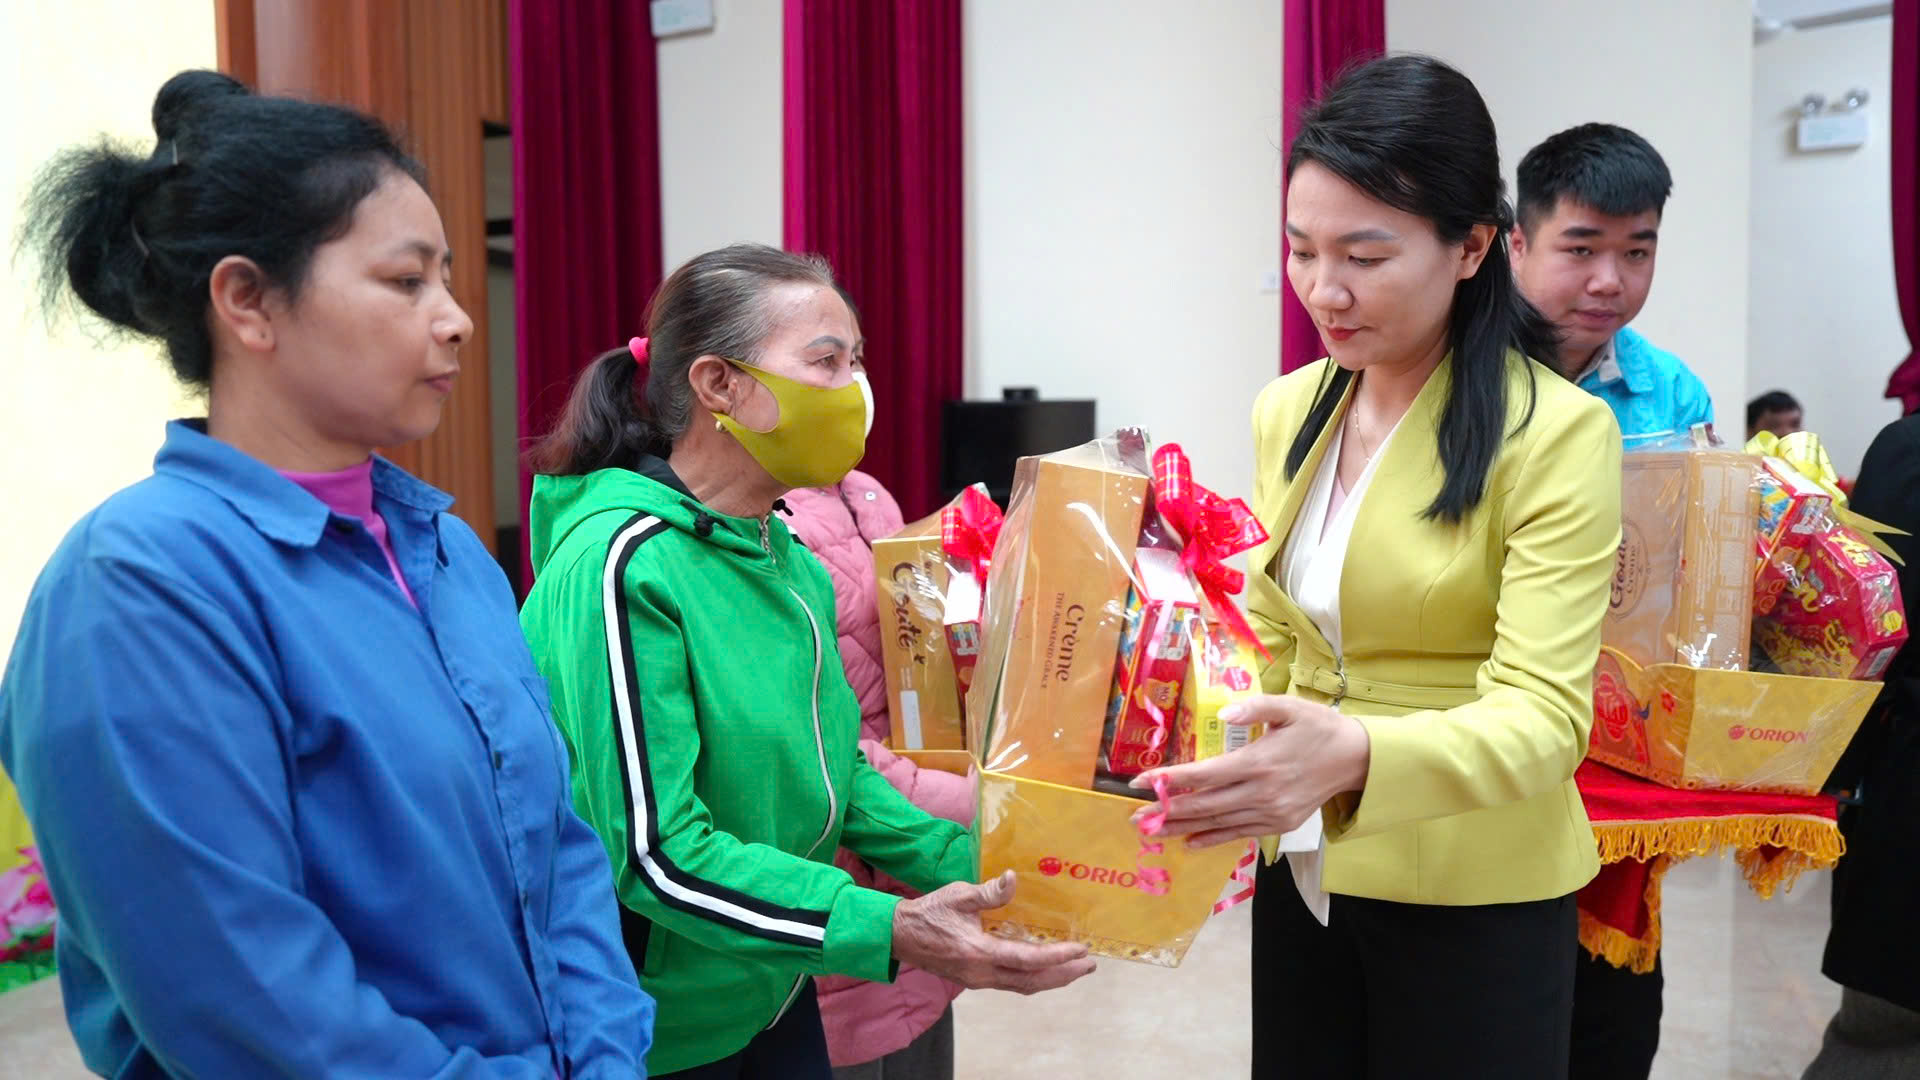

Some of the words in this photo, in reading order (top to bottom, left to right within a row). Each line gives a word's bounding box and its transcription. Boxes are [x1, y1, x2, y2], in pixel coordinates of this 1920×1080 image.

[1056, 604, 1085, 682] Crème
[1748, 727, 1809, 744] ORION
[1070, 863, 1157, 892] ORIO
